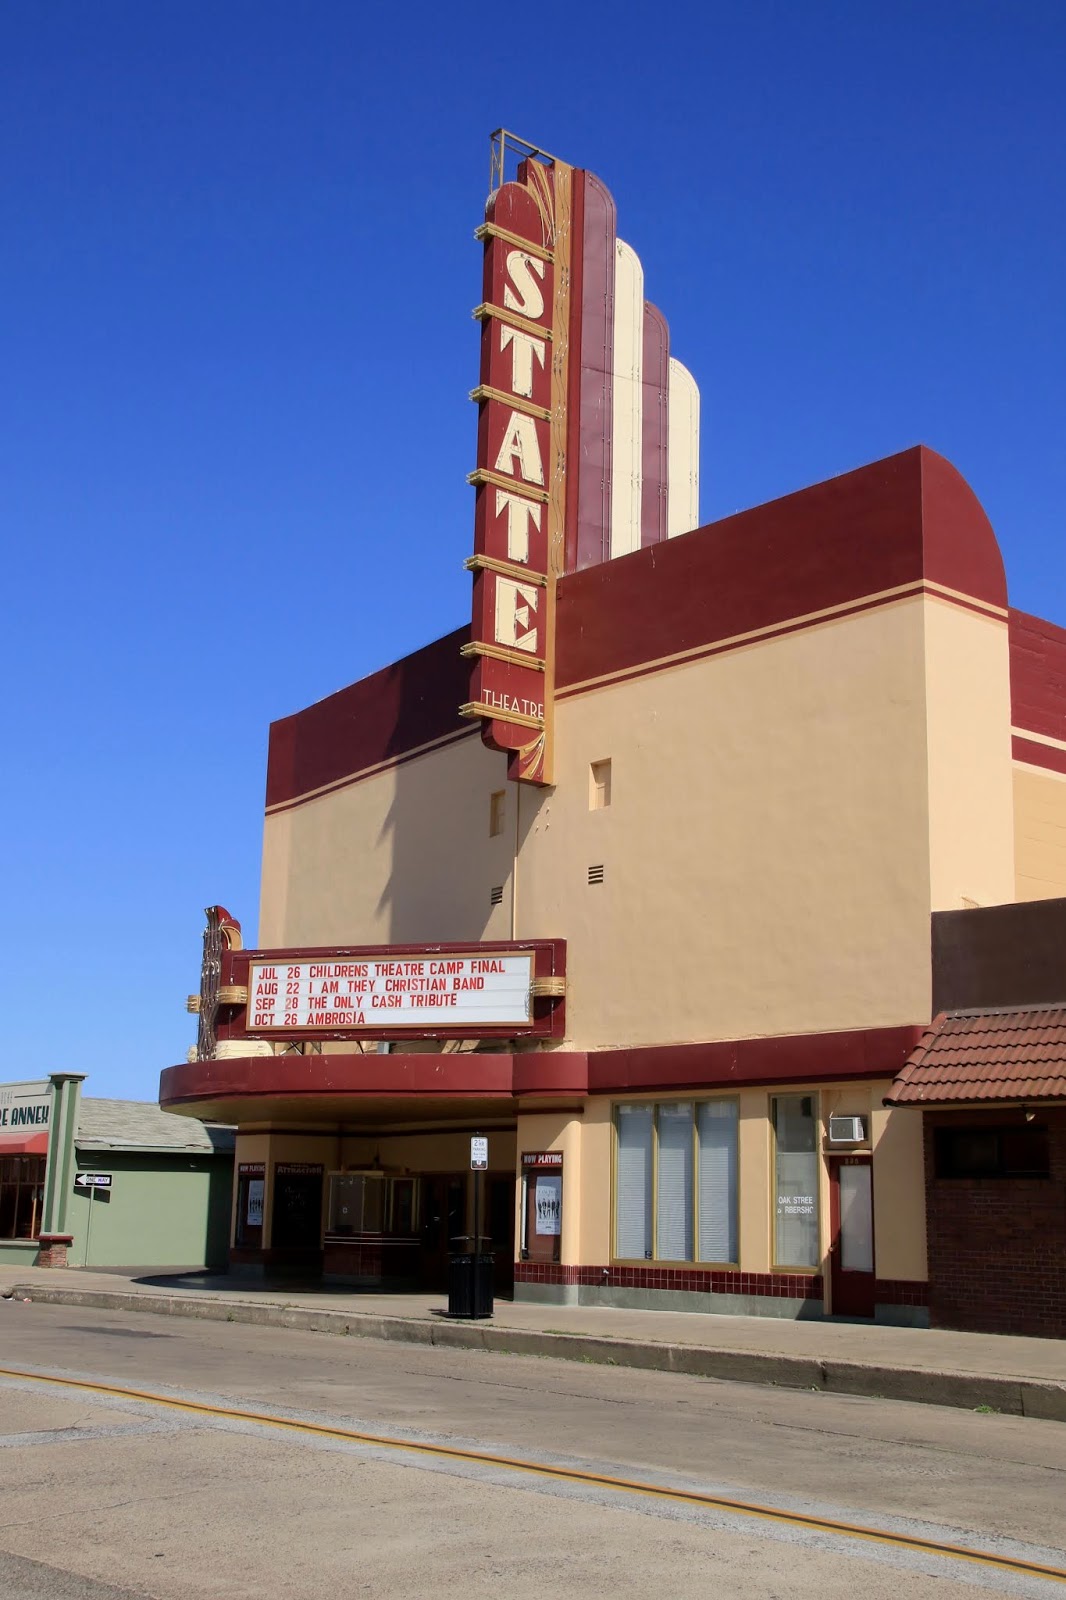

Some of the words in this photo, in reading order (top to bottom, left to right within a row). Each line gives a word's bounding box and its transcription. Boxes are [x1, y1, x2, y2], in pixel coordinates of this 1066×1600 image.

[494, 250, 545, 653] STATE
[483, 689, 544, 719] THEATRE
[259, 967, 278, 979] JUL
[287, 967, 300, 979] 26
[309, 965, 368, 978] CHILDRENS
[375, 963, 424, 976] THEATRE
[430, 962, 464, 975] CAMP
[471, 960, 505, 973] FINAL
[257, 983, 278, 995] AUG
[286, 982, 299, 994] 22
[309, 981, 312, 993] I
[321, 981, 339, 993] AM
[347, 980, 375, 993] THEY
[385, 978, 446, 992] CHRISTIAN
[453, 977, 484, 990] BAND
[256, 998, 275, 1010] SEP
[285, 997, 298, 1010] 28
[308, 997, 327, 1009] THE
[334, 996, 363, 1008] ONLY
[372, 995, 402, 1008] CASH
[410, 993, 457, 1007] TRIBUTE
[254, 1014, 275, 1026] OCT
[284, 1014, 298, 1025] 26
[307, 1012, 365, 1025] AMBROSIA
[11, 1105, 49, 1126] ANNEX
[523, 1155, 536, 1163] NOW
[538, 1154, 562, 1164] PLAYING
[277, 1166, 322, 1175] ATTRACTION
[778, 1196, 791, 1204] OAK
